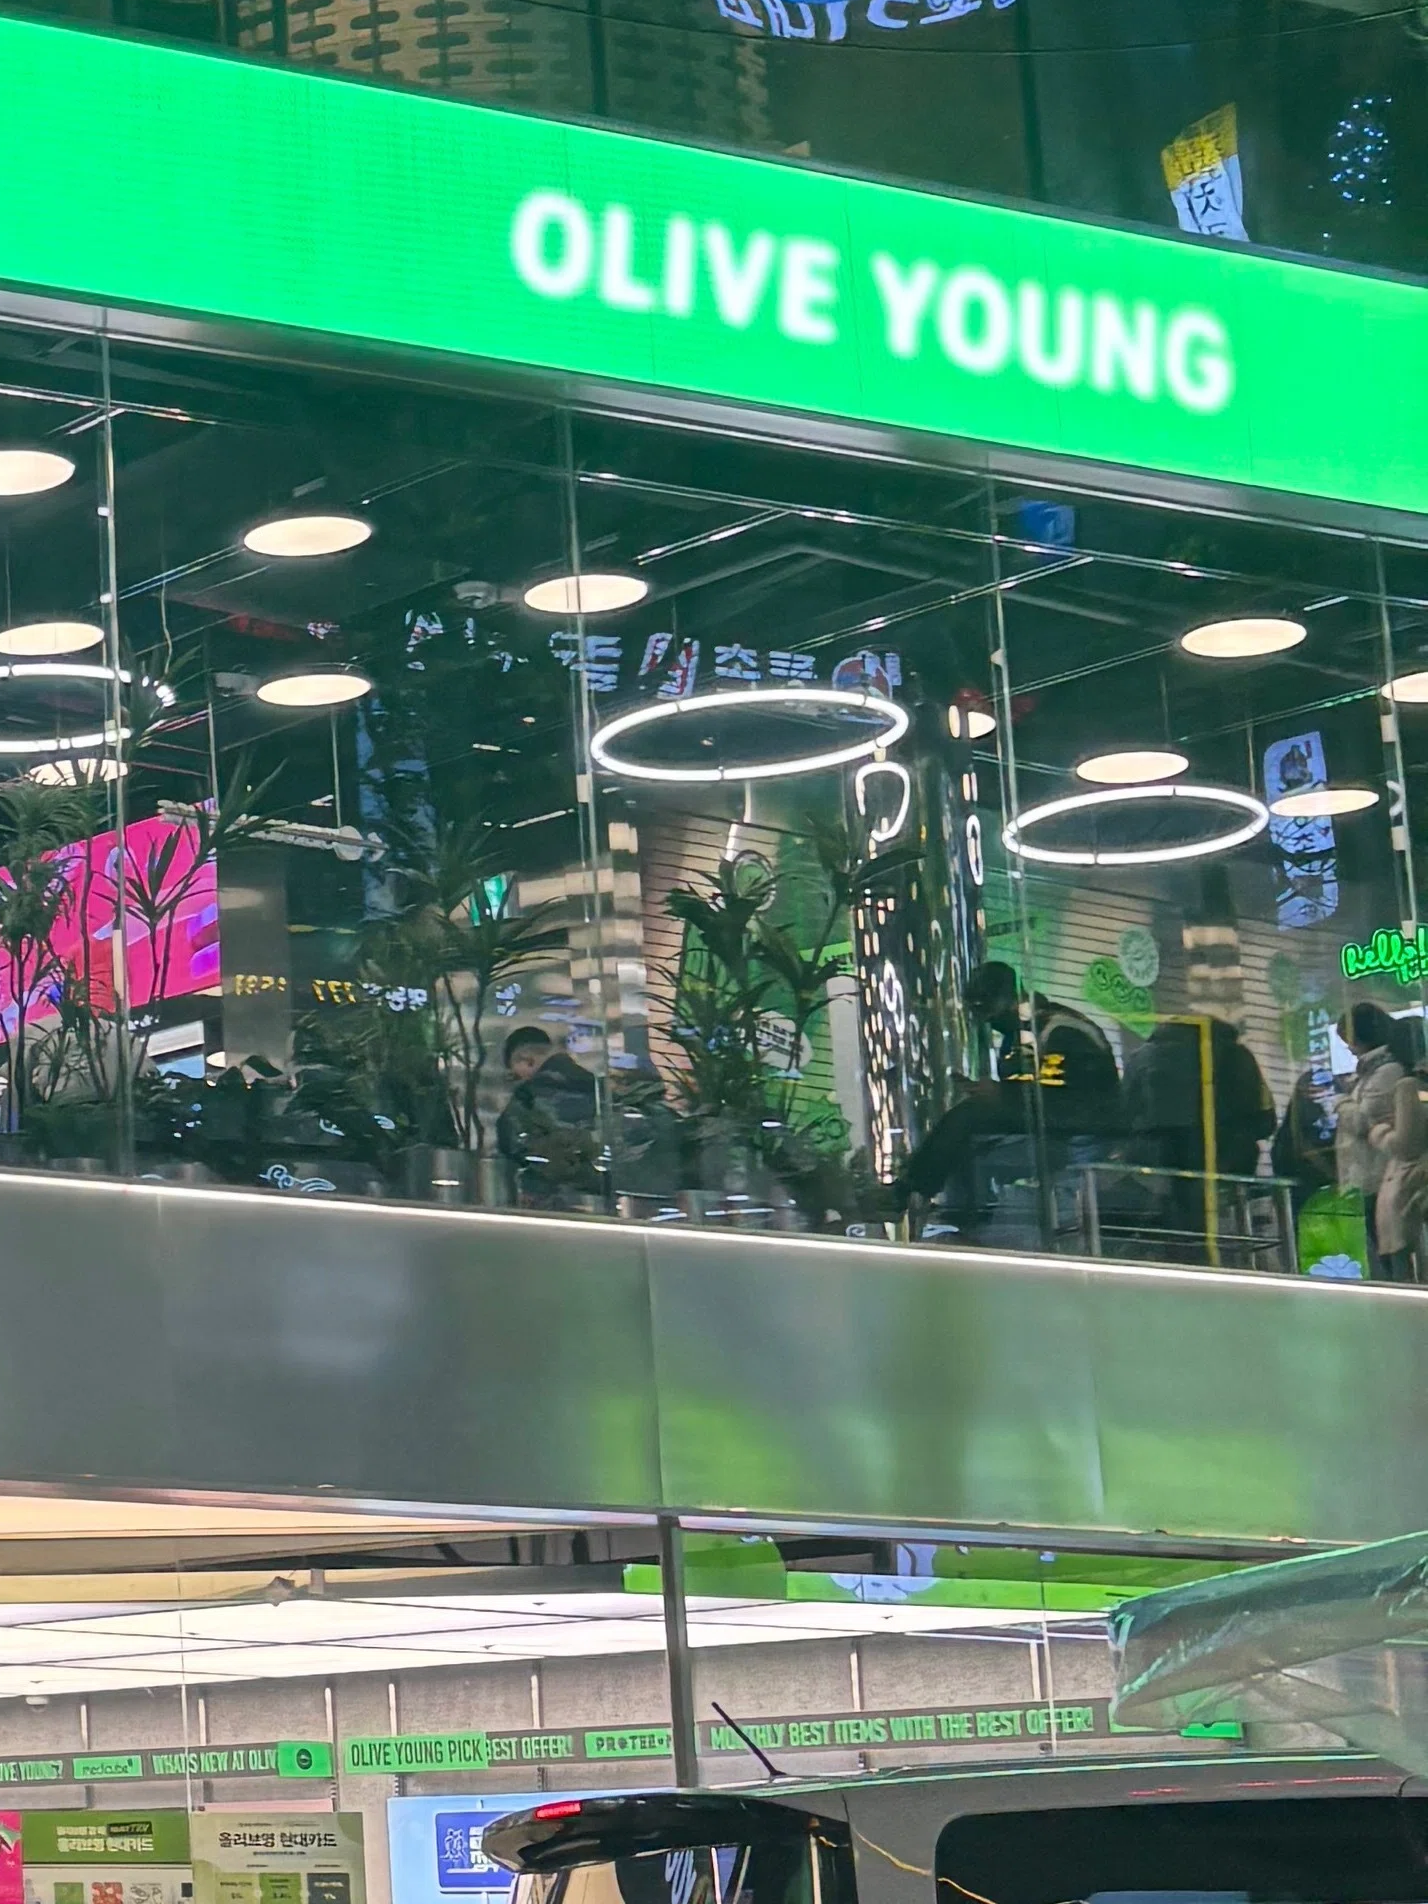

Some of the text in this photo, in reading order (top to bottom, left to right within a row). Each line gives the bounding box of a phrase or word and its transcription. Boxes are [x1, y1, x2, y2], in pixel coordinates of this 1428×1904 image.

[510, 186, 1234, 416] OLIVE YOUNG
[710, 1706, 1095, 1750] MONTHLY BEST ITEMS WITH THE BEST OFFER!
[350, 1737, 486, 1768] OLIVE YOUNG PICK
[218, 1830, 338, 1848] 올리브영 현대카드
